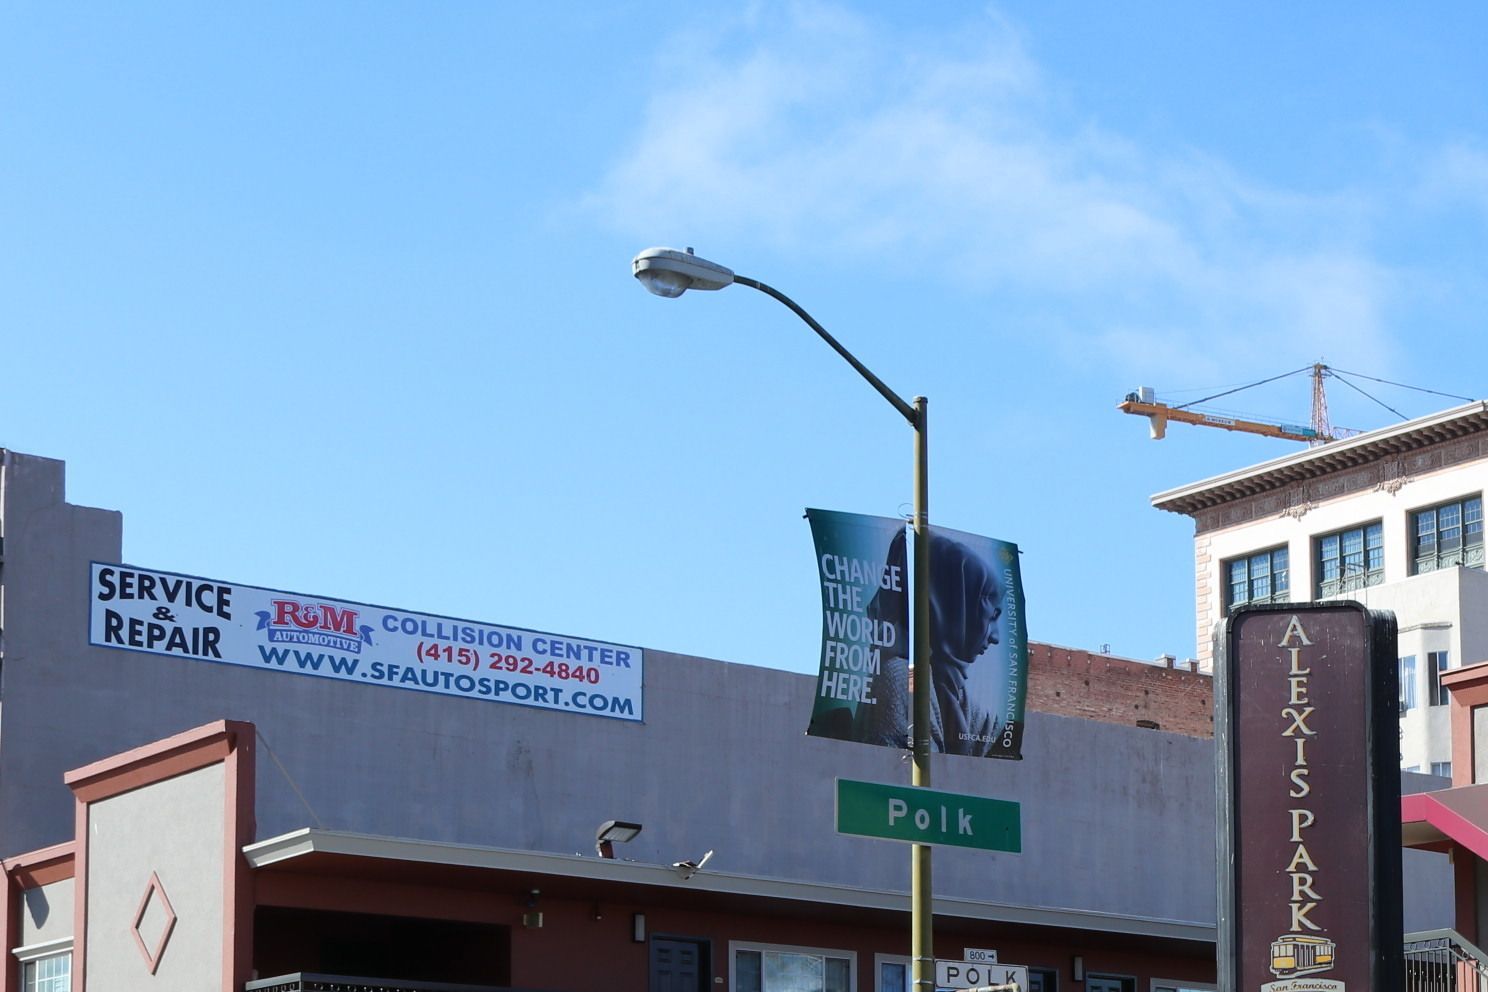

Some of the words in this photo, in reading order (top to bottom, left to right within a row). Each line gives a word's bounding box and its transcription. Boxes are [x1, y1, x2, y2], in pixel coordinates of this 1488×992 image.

[822, 554, 902, 592] CHANGE
[98, 568, 232, 621] SERVICE
[824, 581, 864, 613] THE
[1003, 569, 1018, 635] UNIVERSITY
[152, 606, 176, 622] &
[272, 600, 359, 636] R&M
[826, 611, 896, 648] WORLD
[105, 608, 222, 659] REPAIR
[274, 631, 359, 653] AUTOMOTIVE
[382, 614, 522, 651] COLLISION
[532, 638, 631, 668] CENTER
[1008, 638, 1017, 650] of
[417, 641, 480, 671] (415)
[489, 652, 600, 684] 292-4840
[824, 640, 881, 675] FROM
[1008, 652, 1018, 677] SAN
[258, 645, 634, 715] WWW.SFAUTOSPORT.COM
[821, 671, 877, 705] HERE.
[1003, 682, 1018, 748] FRANCISCO
[1279, 615, 1317, 798] ALEXIS
[888, 799, 974, 836] Polk
[1289, 809, 1323, 932] PARK
[969, 951, 985, 960] 800
[947, 966, 1017, 985] POLK
[1269, 983, 1288, 992] San
[1290, 981, 1337, 991] Francisco
